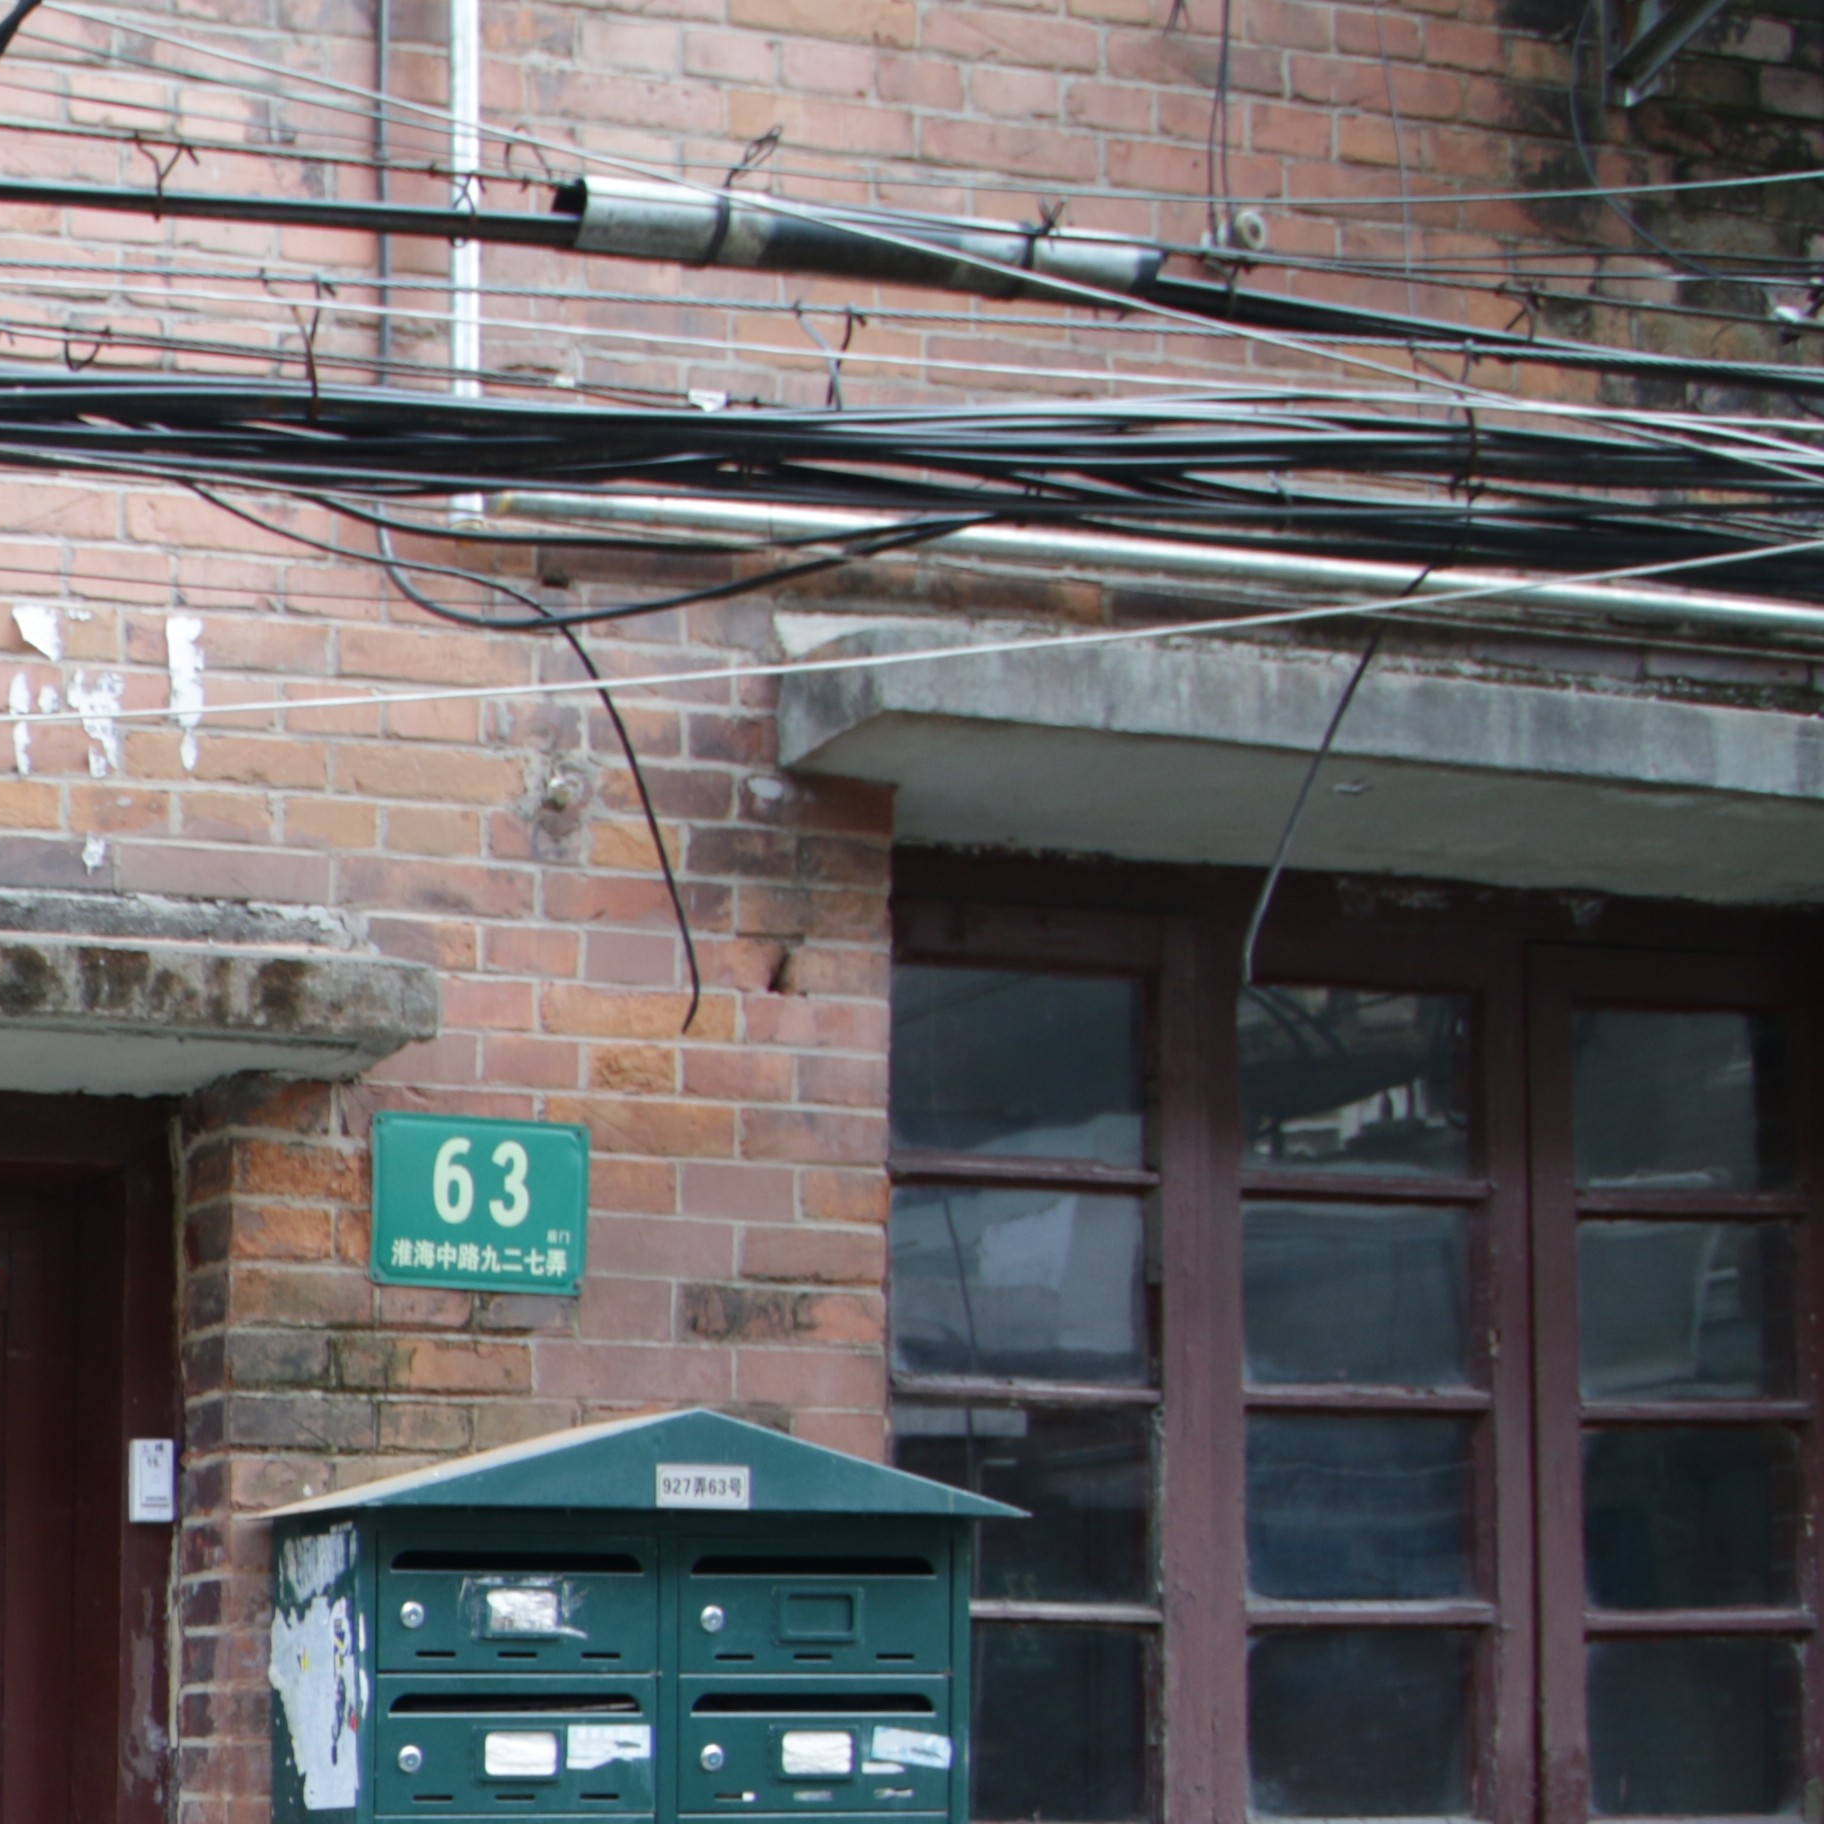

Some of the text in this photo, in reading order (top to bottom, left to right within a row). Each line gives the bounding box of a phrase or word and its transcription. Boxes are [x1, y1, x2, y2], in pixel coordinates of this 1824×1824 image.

[433, 1137, 530, 1228] 63
[391, 1239, 568, 1278] 淮海中路九二七弄
[662, 1476, 743, 1498] 927弄63号
